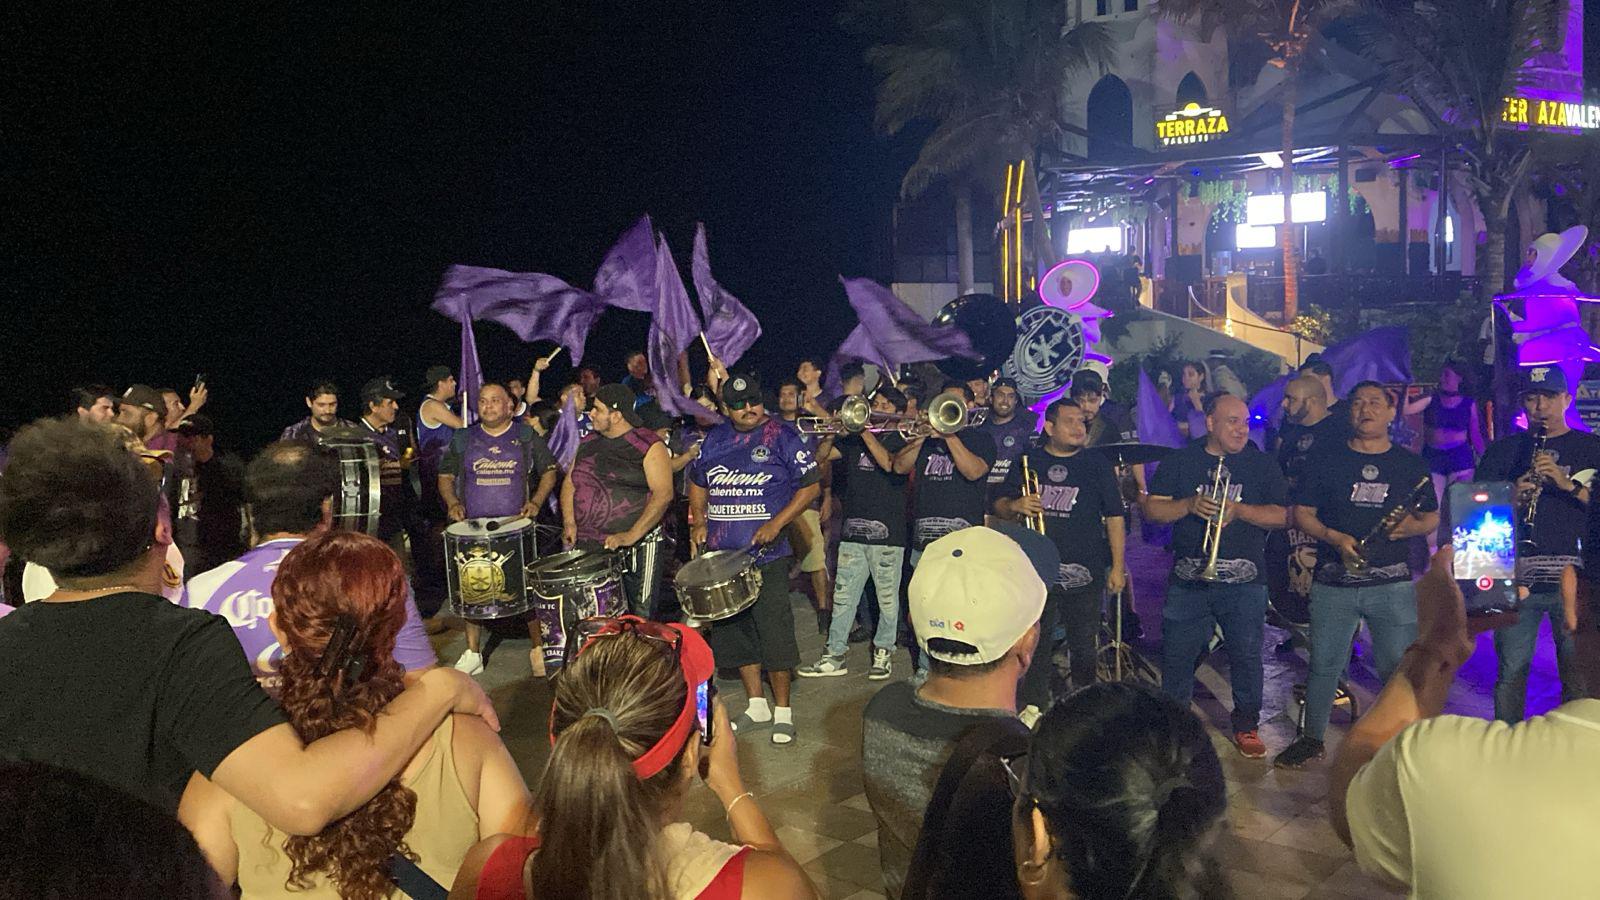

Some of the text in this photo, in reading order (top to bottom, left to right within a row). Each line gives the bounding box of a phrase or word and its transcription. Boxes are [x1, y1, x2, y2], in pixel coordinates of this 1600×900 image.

[1502, 97, 1567, 126] ERAZA
[1156, 116, 1229, 138] TERRAZA
[473, 457, 518, 471] Caliente
[706, 465, 773, 487] Caliente
[709, 487, 765, 497] aliente.mx
[708, 502, 767, 514] QUETEXPRESS
